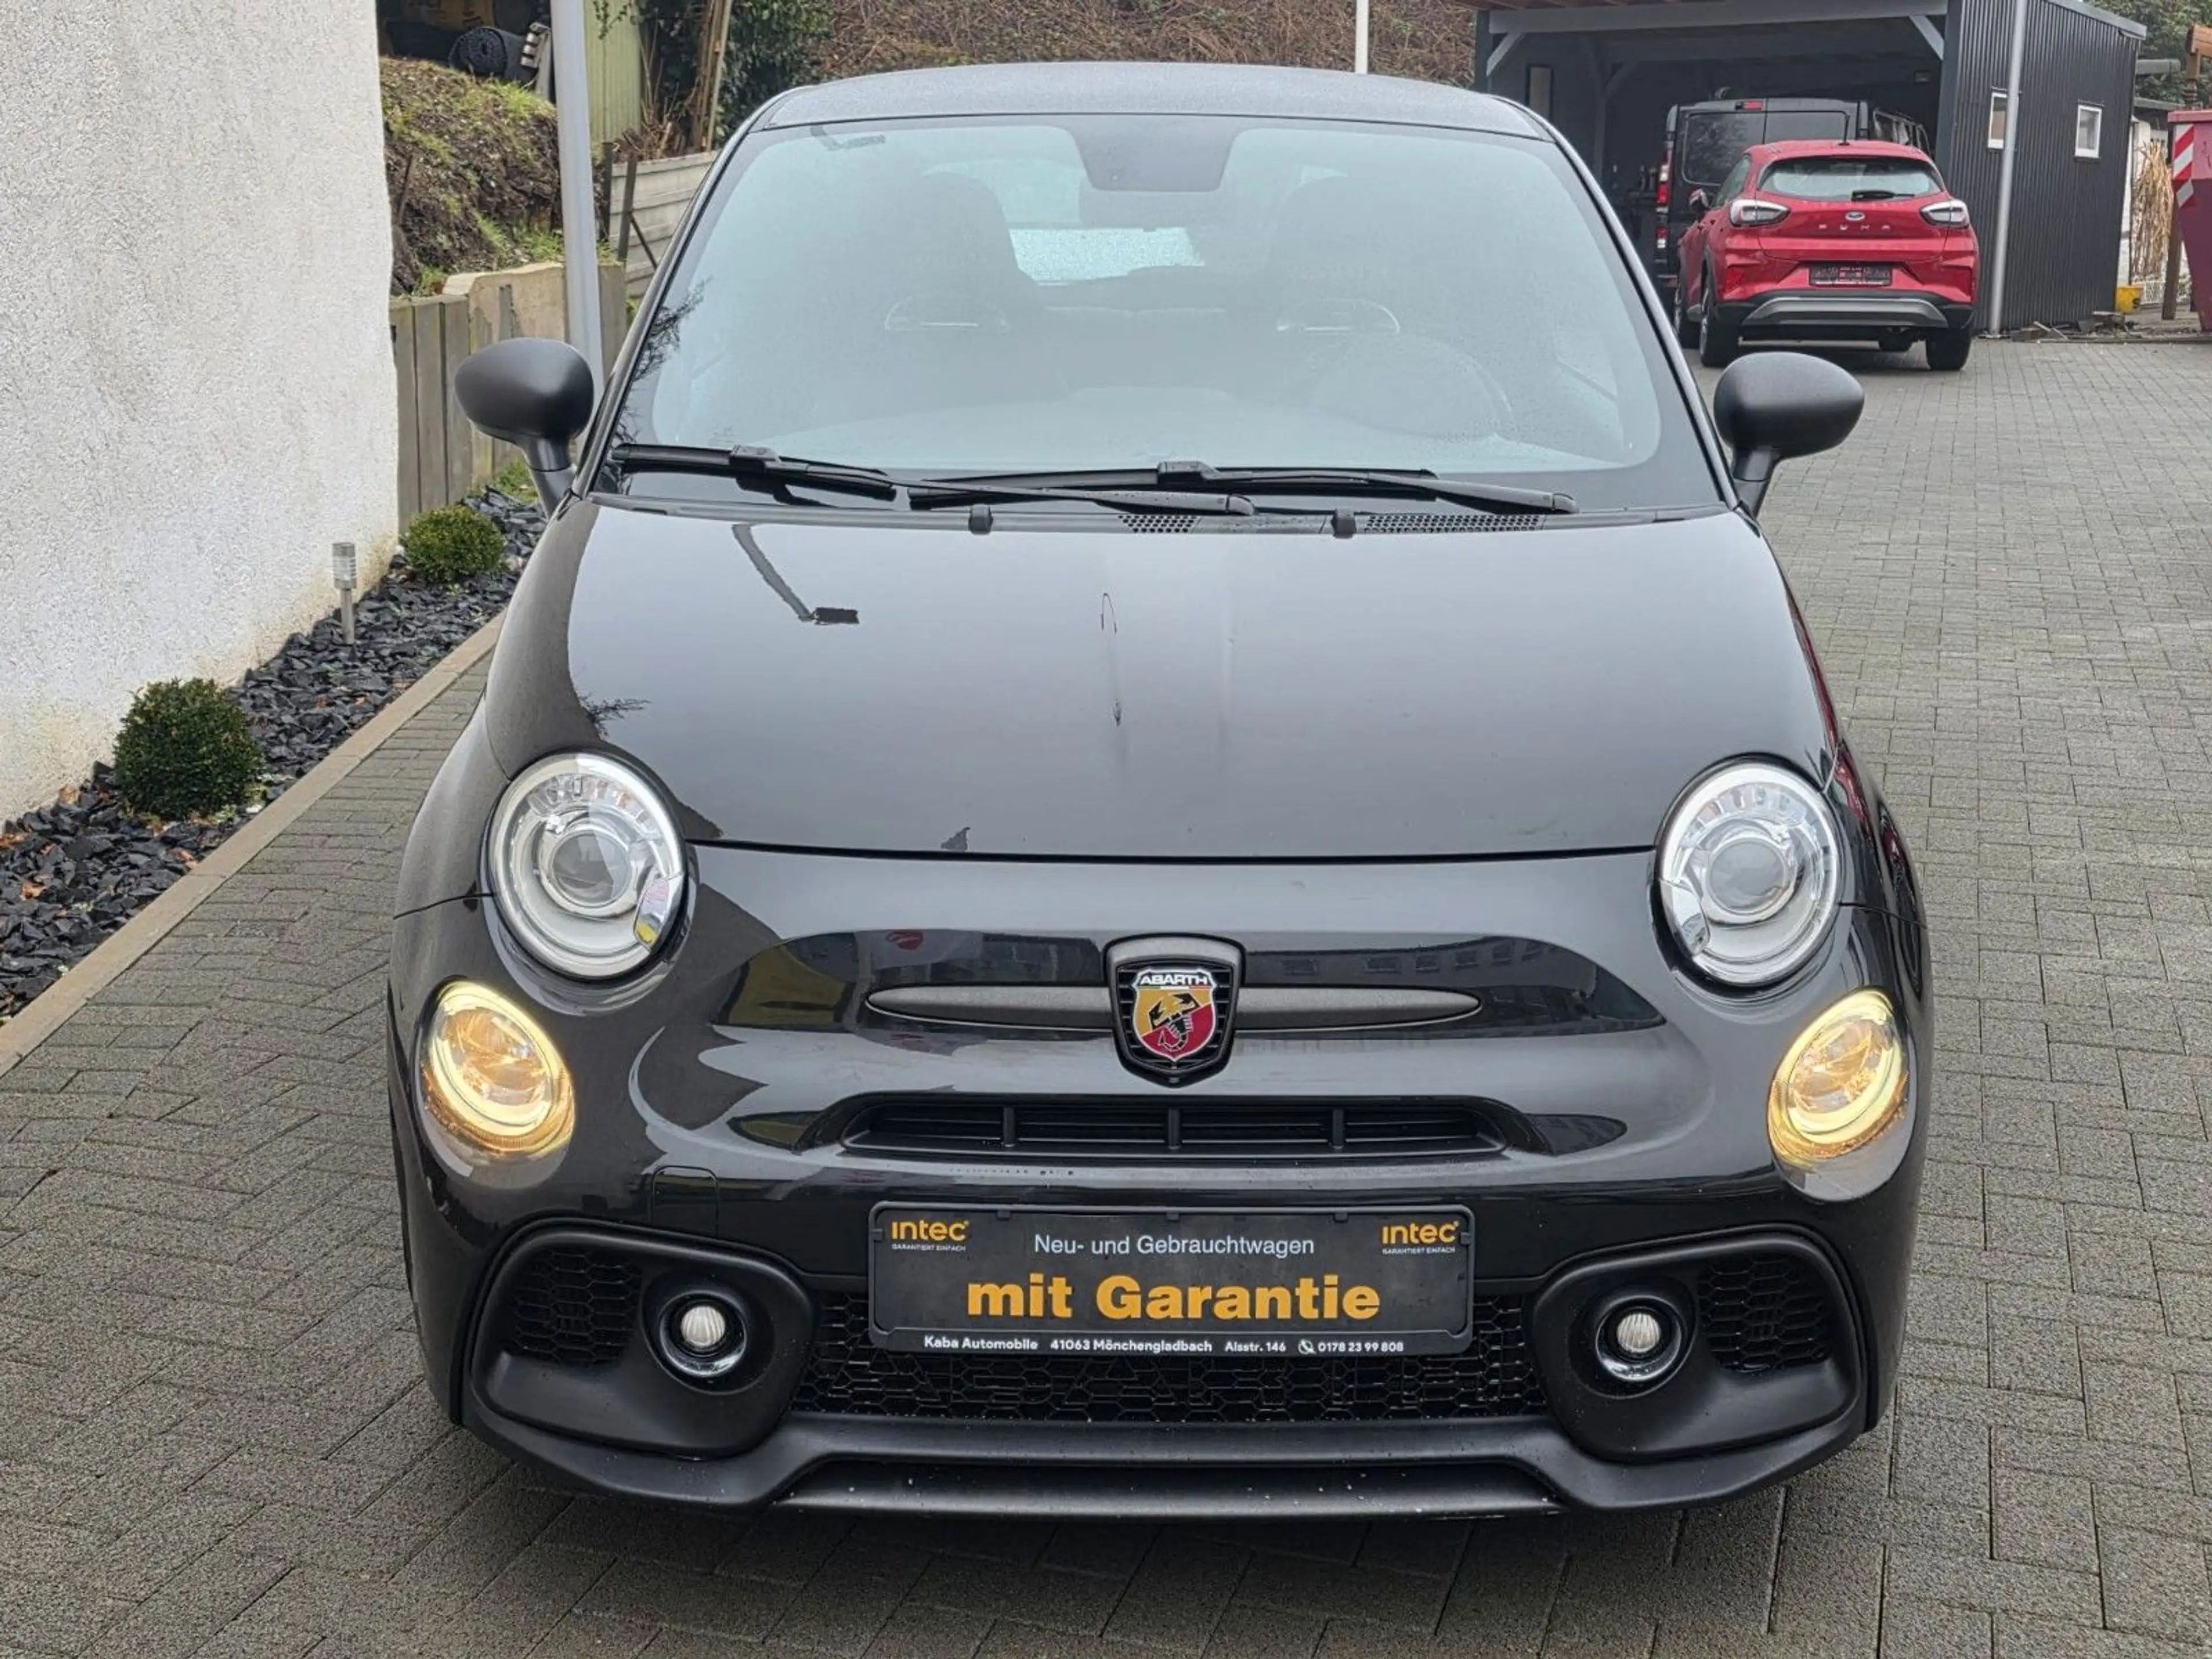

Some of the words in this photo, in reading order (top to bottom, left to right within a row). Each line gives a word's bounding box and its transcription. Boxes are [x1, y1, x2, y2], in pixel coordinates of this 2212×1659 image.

[1140, 974, 1208, 985] ABARTH
[891, 1219, 967, 1241] intec
[1382, 1222, 1456, 1244] intec
[1035, 1234, 1084, 1253] Neu-
[1092, 1236, 1130, 1254] und
[1137, 1235, 1314, 1259] Gebrauchtwagen
[967, 1273, 1072, 1318] mit
[1096, 1274, 1381, 1320] Garantie
[924, 1335, 959, 1349] Kaba
[962, 1337, 1038, 1351] Automobile
[1050, 1338, 1090, 1351] 41063
[1093, 1338, 1213, 1354] Mönchengladbach
[1266, 1341, 1286, 1352] 146
[1317, 1341, 1346, 1353] 0178
[1348, 1342, 1362, 1353] 23
[1364, 1342, 1378, 1353] 99
[1381, 1342, 1404, 1353] 808
